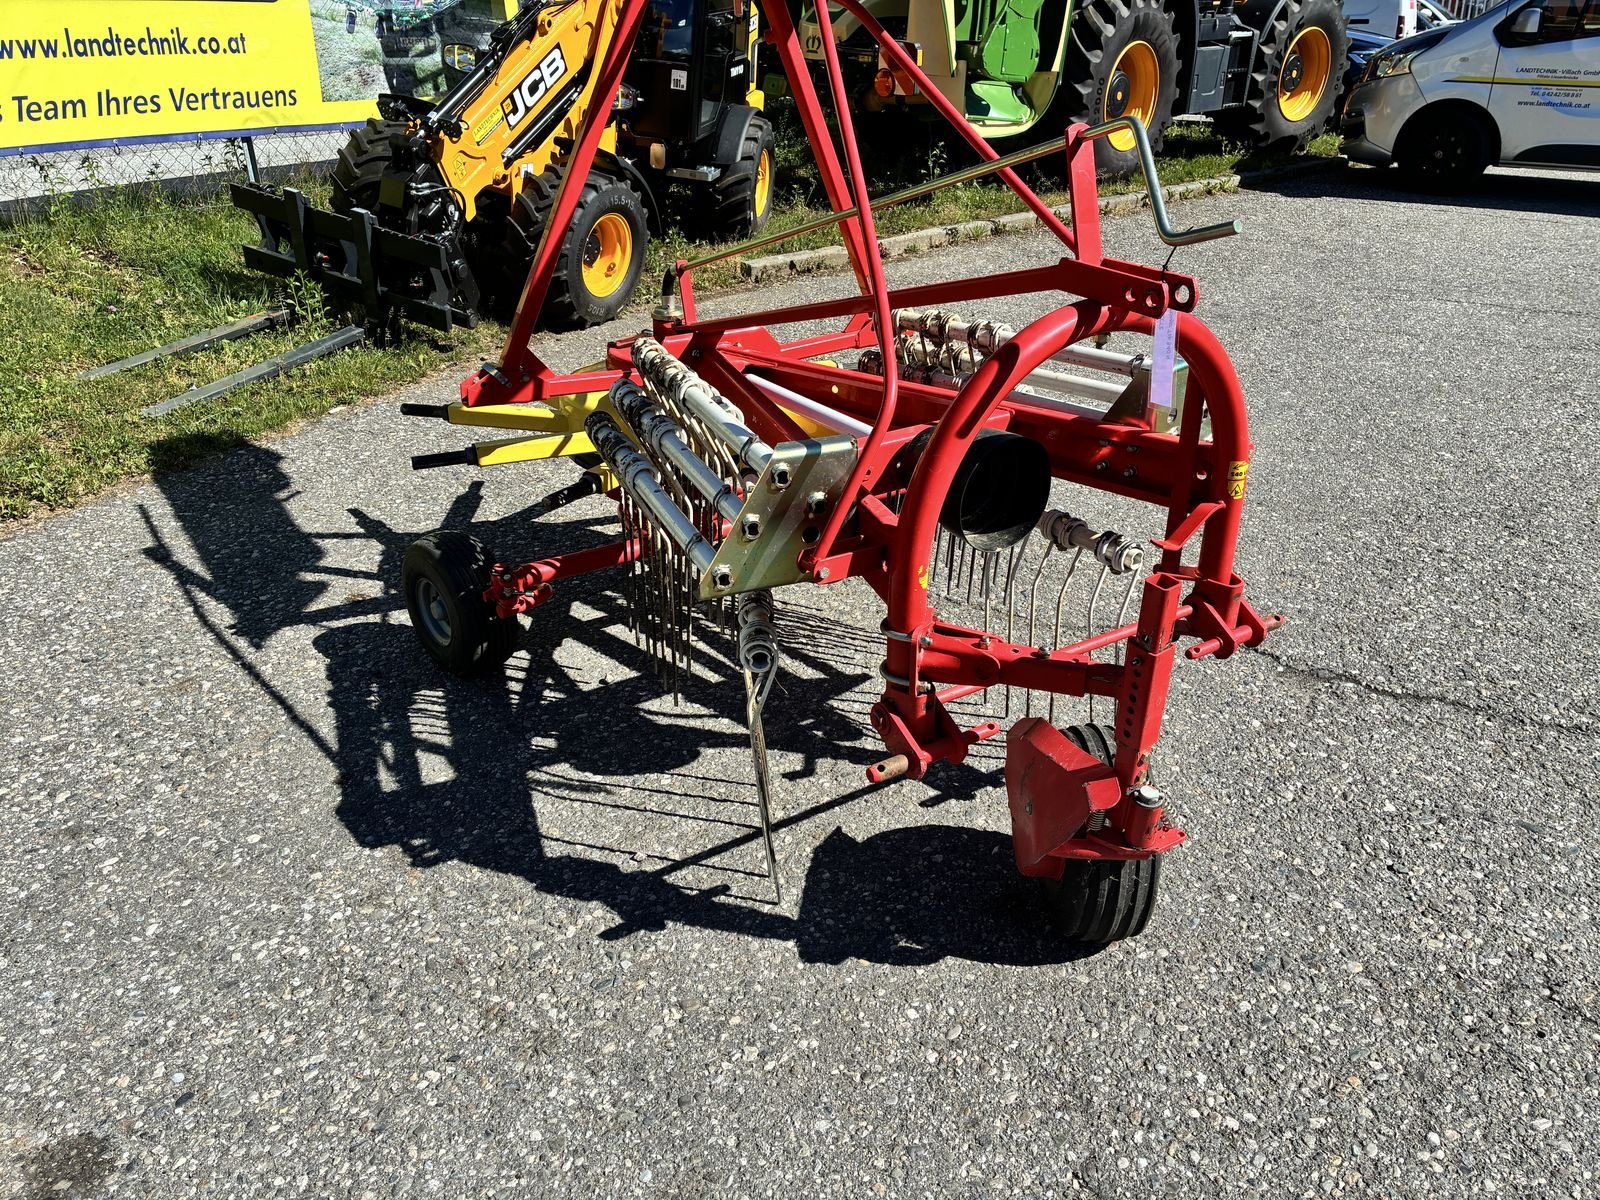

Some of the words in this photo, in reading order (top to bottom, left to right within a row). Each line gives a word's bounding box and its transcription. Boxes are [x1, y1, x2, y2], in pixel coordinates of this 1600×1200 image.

[0, 27, 247, 59] www.landtechnik.co.at
[507, 48, 566, 126] JCB
[12, 96, 87, 122] Team
[97, 90, 161, 118] Ihres
[168, 88, 297, 112] Vertrauens
[1517, 100, 1591, 109] www.landtechnik.co.at
